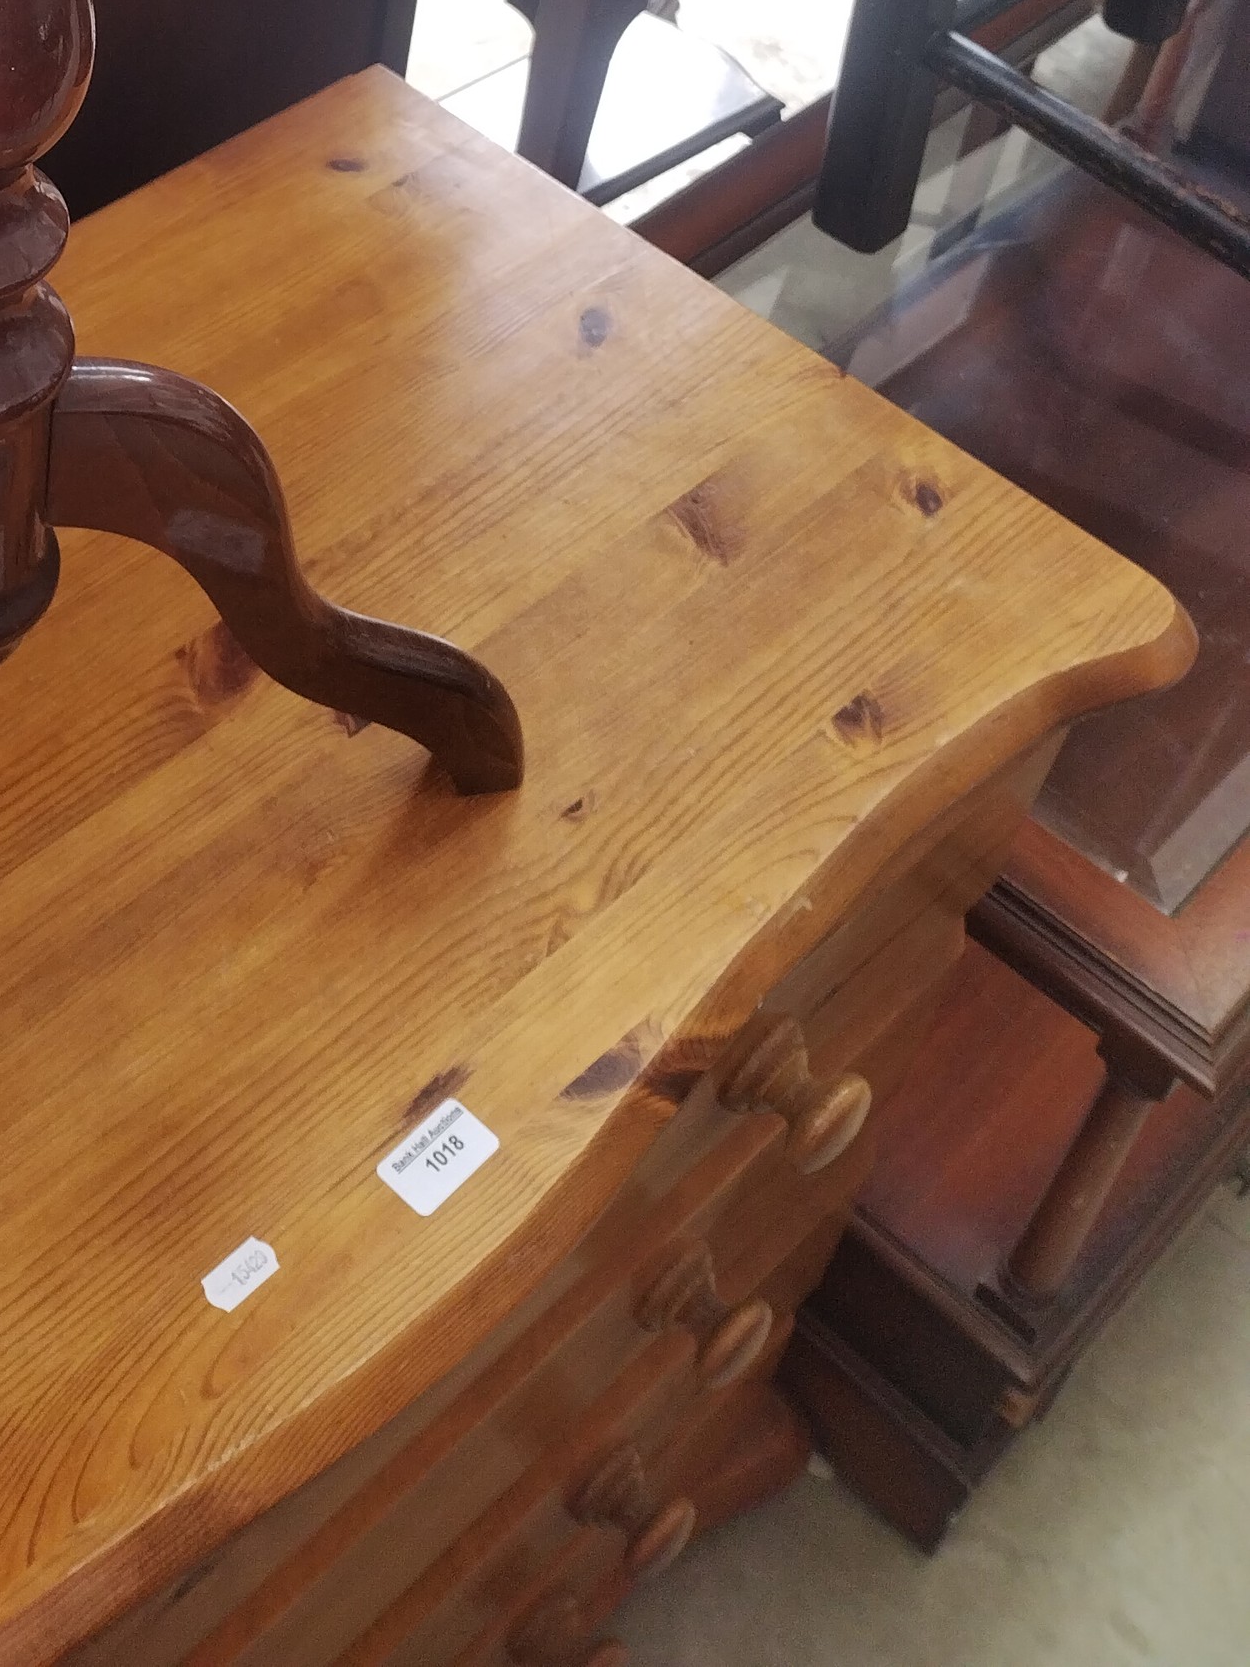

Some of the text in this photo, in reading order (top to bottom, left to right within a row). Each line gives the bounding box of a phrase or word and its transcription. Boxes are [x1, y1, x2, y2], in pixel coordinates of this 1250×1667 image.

[391, 1106, 463, 1173] Bank Hall Auctions
[425, 1135, 464, 1172] 1018
